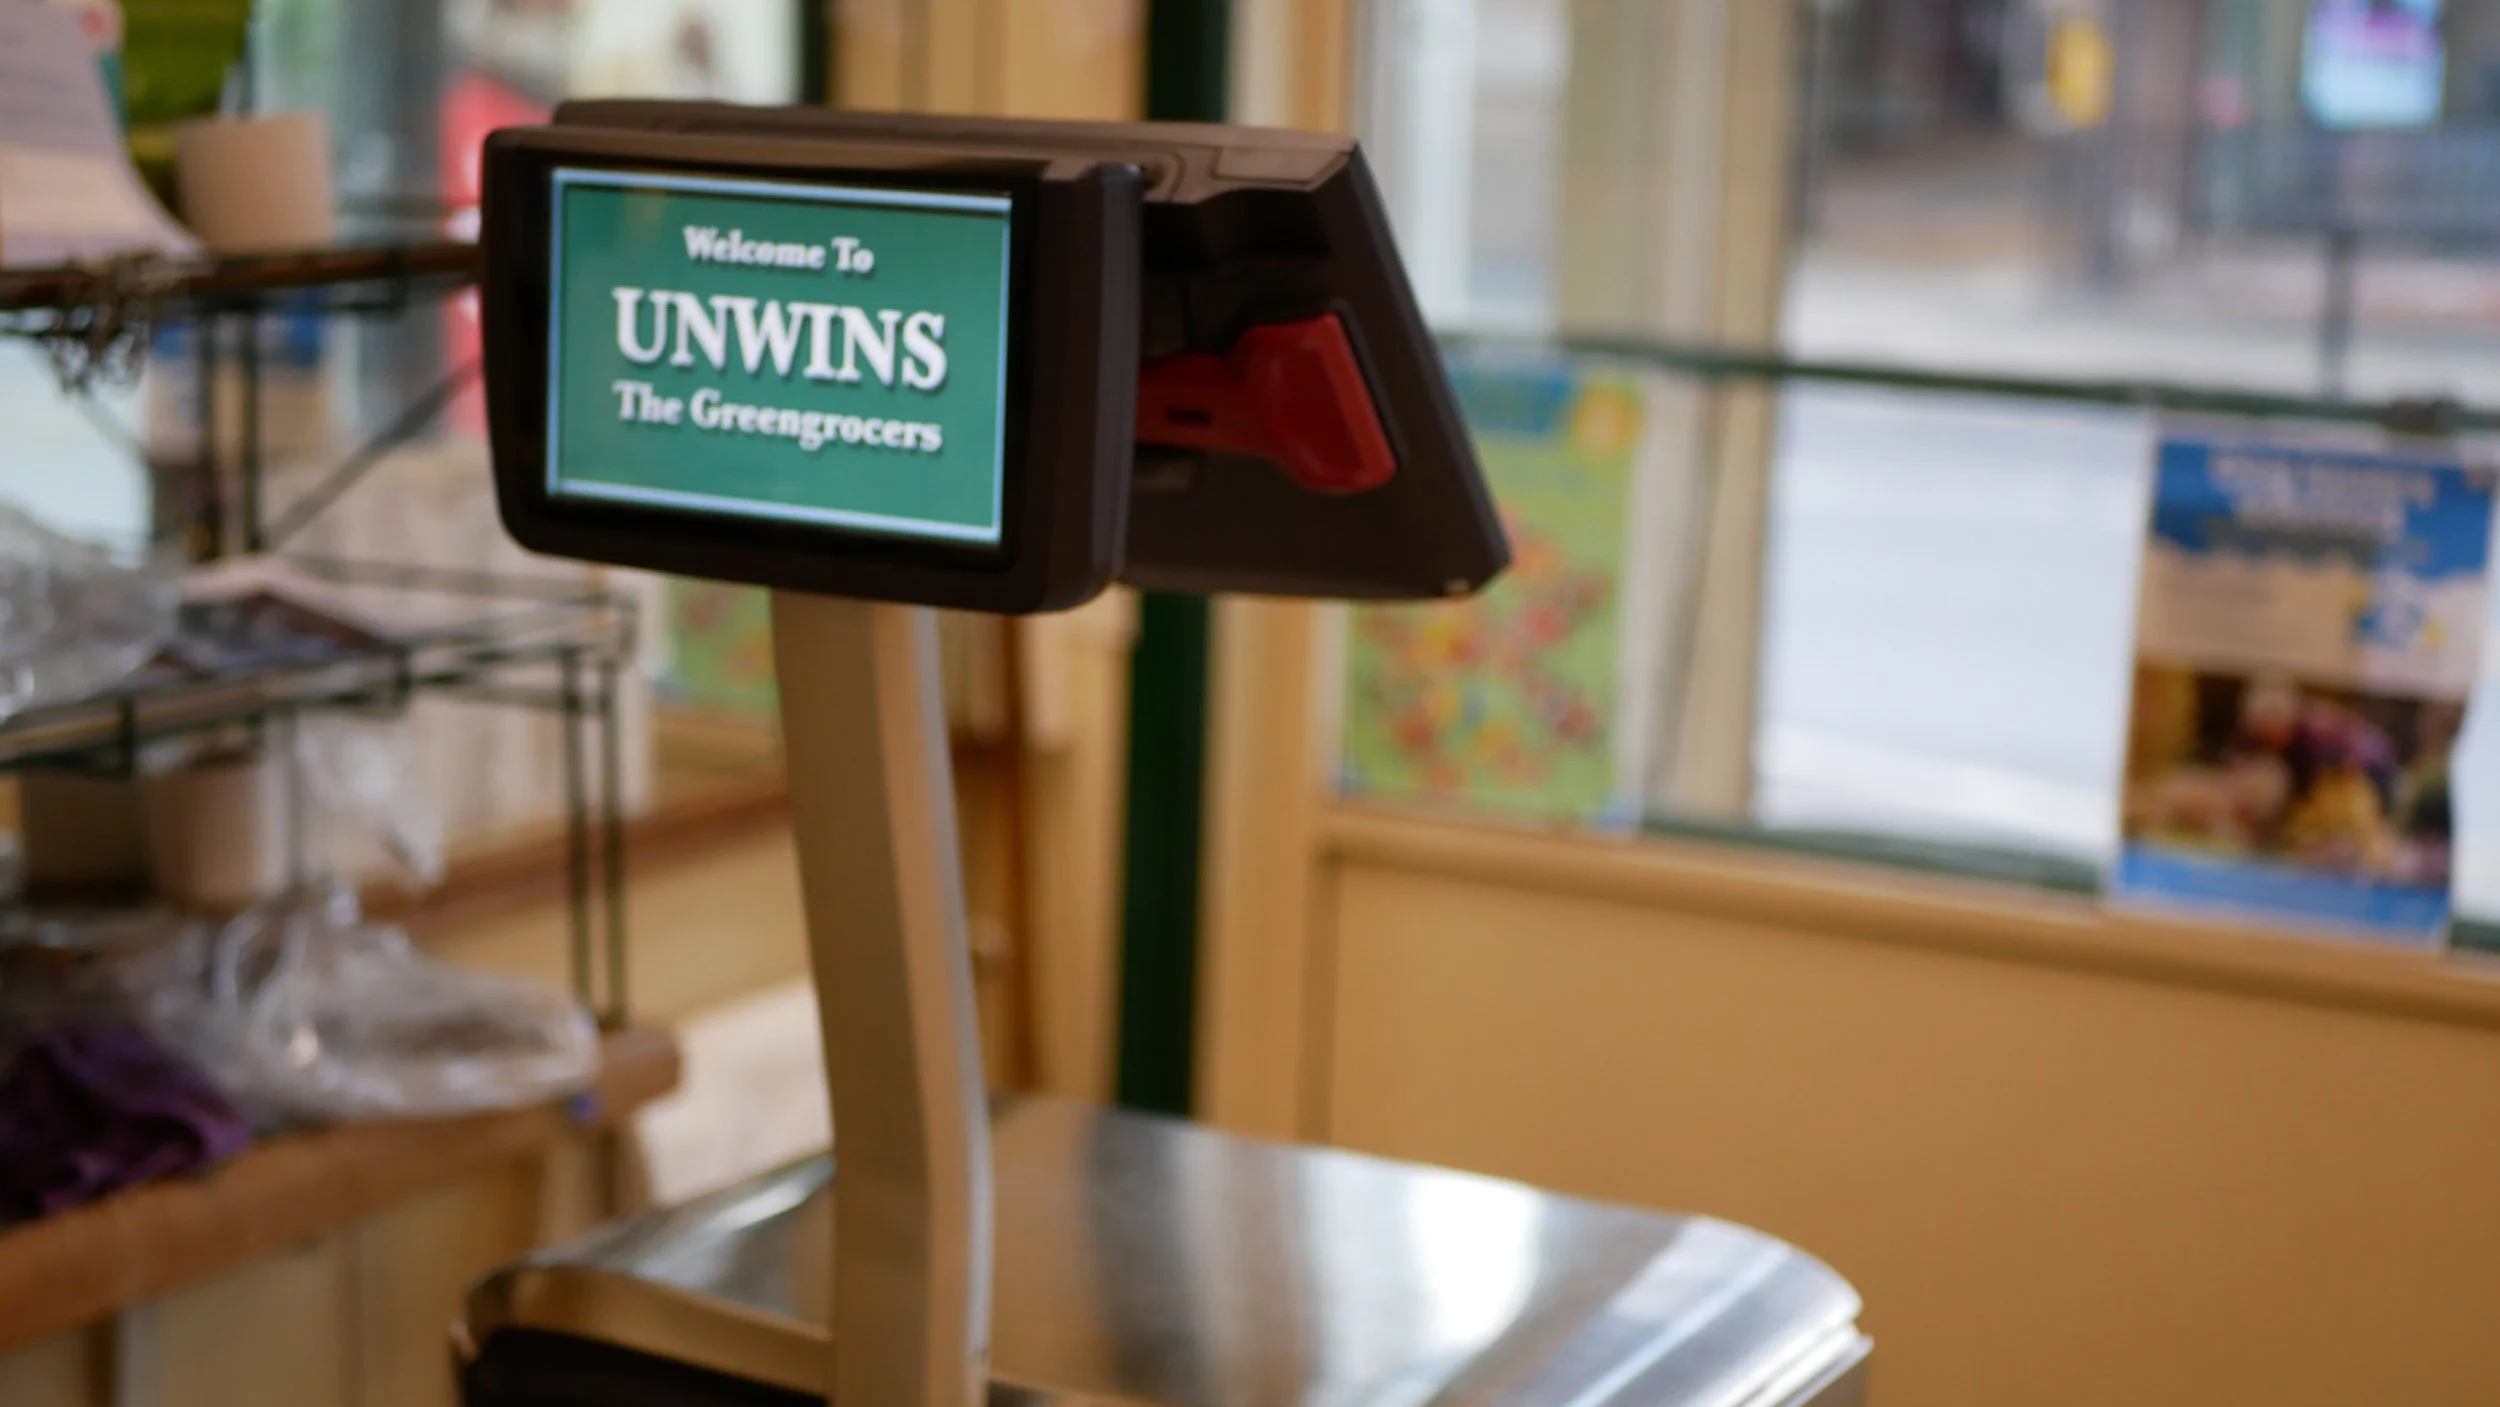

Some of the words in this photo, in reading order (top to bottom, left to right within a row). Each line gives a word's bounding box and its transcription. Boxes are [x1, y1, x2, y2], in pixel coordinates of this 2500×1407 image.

[683, 226, 825, 271] Welcome
[831, 237, 874, 274] To
[612, 287, 948, 390] UNWINS
[613, 381, 683, 425] The
[690, 388, 942, 451] Greengrocers
